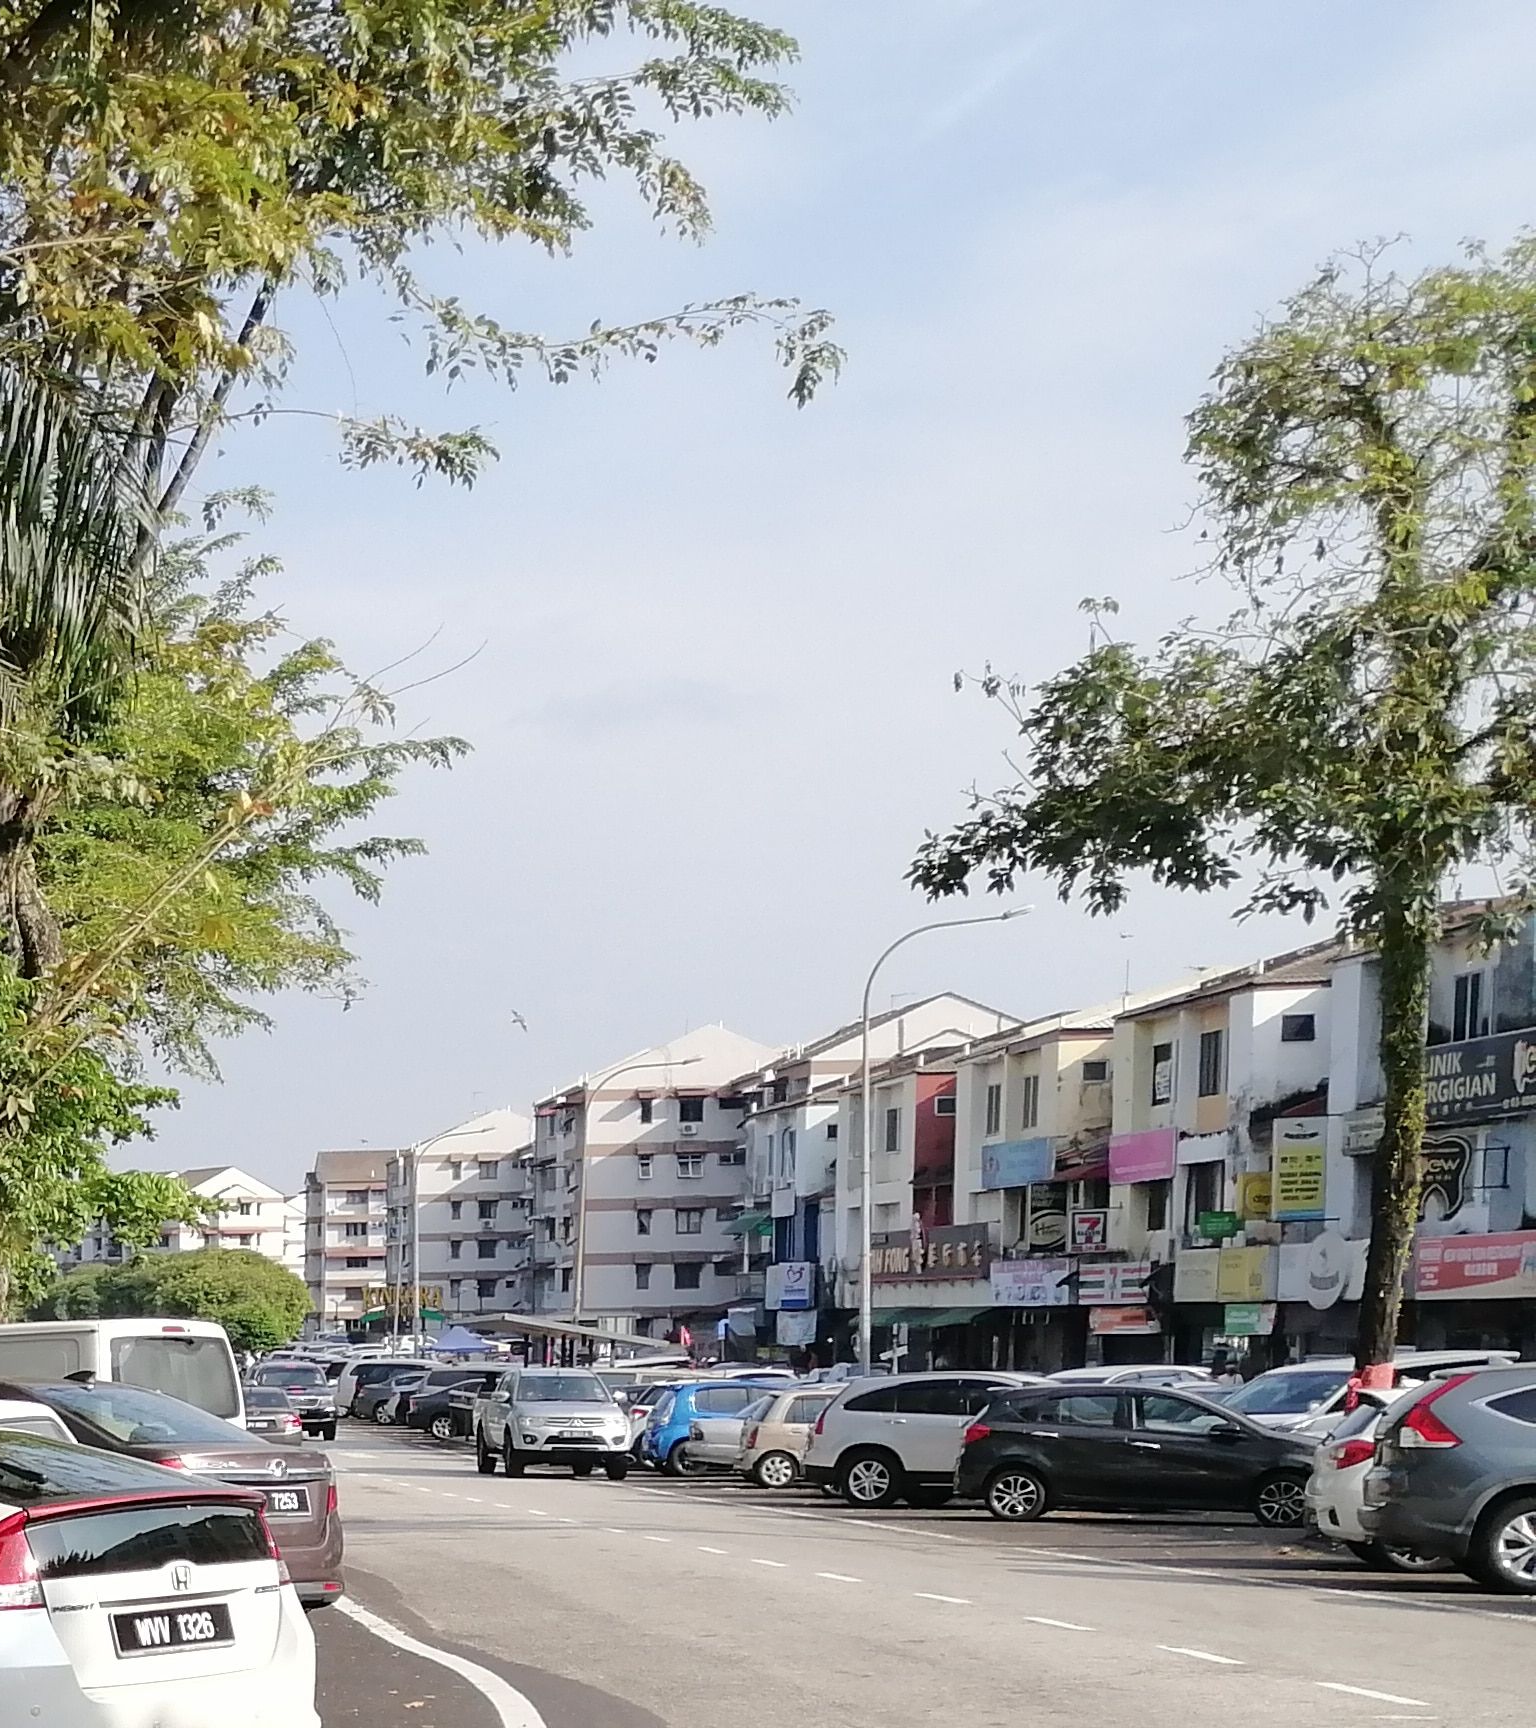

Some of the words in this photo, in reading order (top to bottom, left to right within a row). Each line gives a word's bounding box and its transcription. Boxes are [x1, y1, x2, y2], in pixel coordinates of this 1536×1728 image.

[1430, 1052, 1463, 1077] INIK
[1428, 1072, 1496, 1105] RGIGIAN
[134, 1615, 172, 1647] WVV
[176, 1611, 217, 1642] 1326
